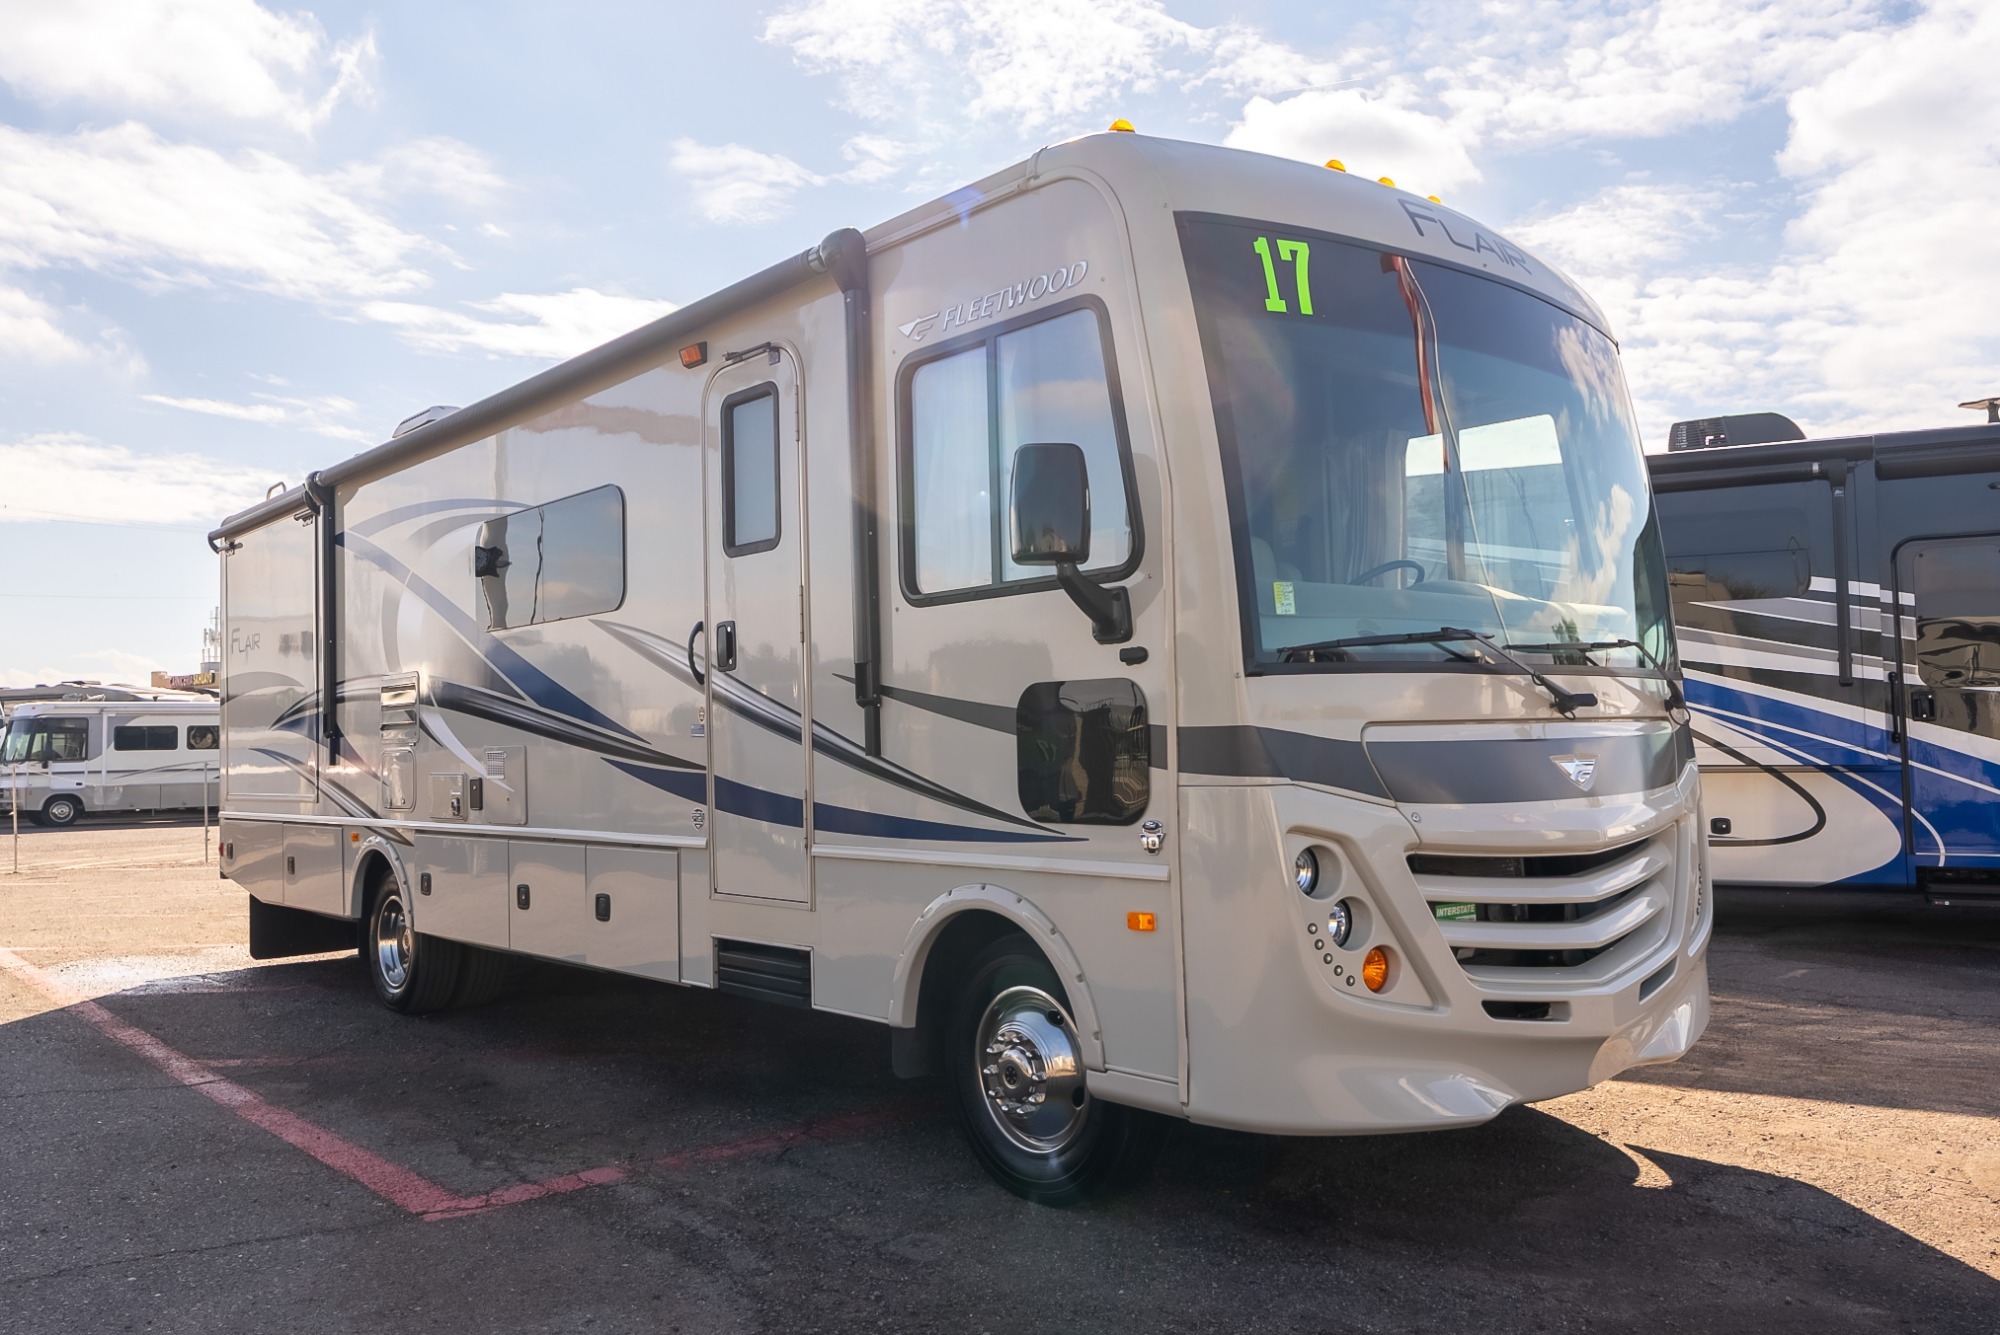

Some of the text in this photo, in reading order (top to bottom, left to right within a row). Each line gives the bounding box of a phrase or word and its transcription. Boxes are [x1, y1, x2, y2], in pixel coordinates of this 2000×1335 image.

[1397, 198, 1532, 275] FLAIR
[942, 260, 1088, 332] FLEETWOOD
[1253, 237, 1313, 315] 17
[231, 627, 260, 655] FLAIR
[1436, 904, 1476, 918] INTERSTATE
